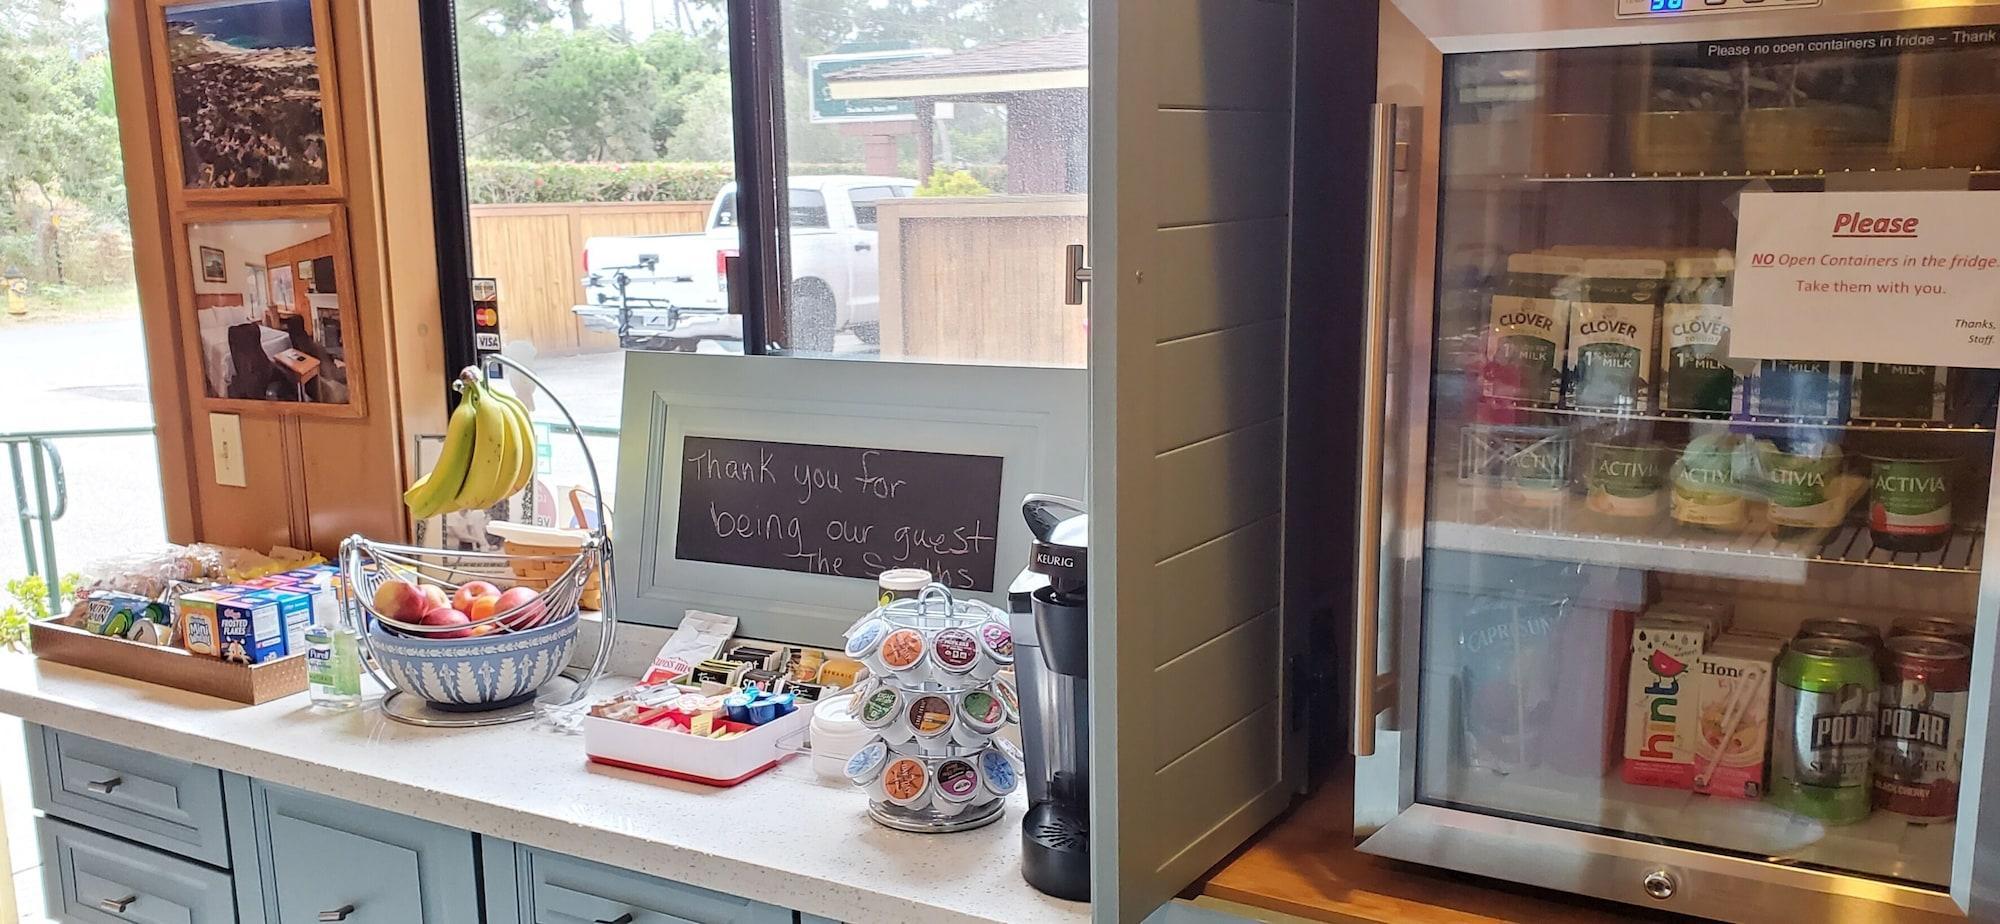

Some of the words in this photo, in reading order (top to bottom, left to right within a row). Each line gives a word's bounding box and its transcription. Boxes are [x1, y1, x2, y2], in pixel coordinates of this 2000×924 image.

[1707, 44, 1751, 57] Please
[1754, 45, 1770, 55] no
[1773, 43, 1805, 56] open
[1807, 36, 1877, 52] containers
[1880, 35, 1892, 48] in
[1895, 32, 1935, 47] fridge
[1952, 29, 1997, 44] Thank
[1832, 212, 1920, 236] Please
[1751, 253, 1775, 268] NO
[1778, 253, 1816, 270] Open
[1819, 253, 1899, 268] Containers
[1902, 253, 1918, 267] in
[1921, 253, 1947, 268] the
[1796, 280, 1831, 294] Take
[1834, 280, 1872, 294] them
[1876, 280, 1910, 295] with
[1914, 282, 1947, 297] you.
[1499, 312, 1553, 331] CLOVER
[1579, 320, 1637, 339] CLOVER
[1672, 321, 1731, 337] CLOVER
[1953, 318, 1998, 331] Thanks,
[479, 336, 499, 348] VISA
[1967, 333, 1996, 346] Staff.
[1519, 350, 1547, 361] MILK
[1602, 357, 1633, 369] MILK
[1695, 357, 1726, 370] MILK
[1788, 361, 1820, 374] MILK
[1890, 364, 1927, 376] MILK
[687, 447, 777, 485] Thank
[793, 464, 843, 505] you
[855, 451, 907, 499] for
[1875, 474, 1945, 493] ACTIVIA
[710, 501, 803, 557] being
[826, 519, 875, 545] our
[894, 519, 995, 561] guest
[798, 547, 844, 576] The
[1036, 552, 1074, 568] KEURIG
[221, 618, 249, 629] FROSTED
[223, 626, 247, 636] FLAKES
[1640, 679, 1680, 760] hint
[1880, 708, 1944, 746] POLAR
